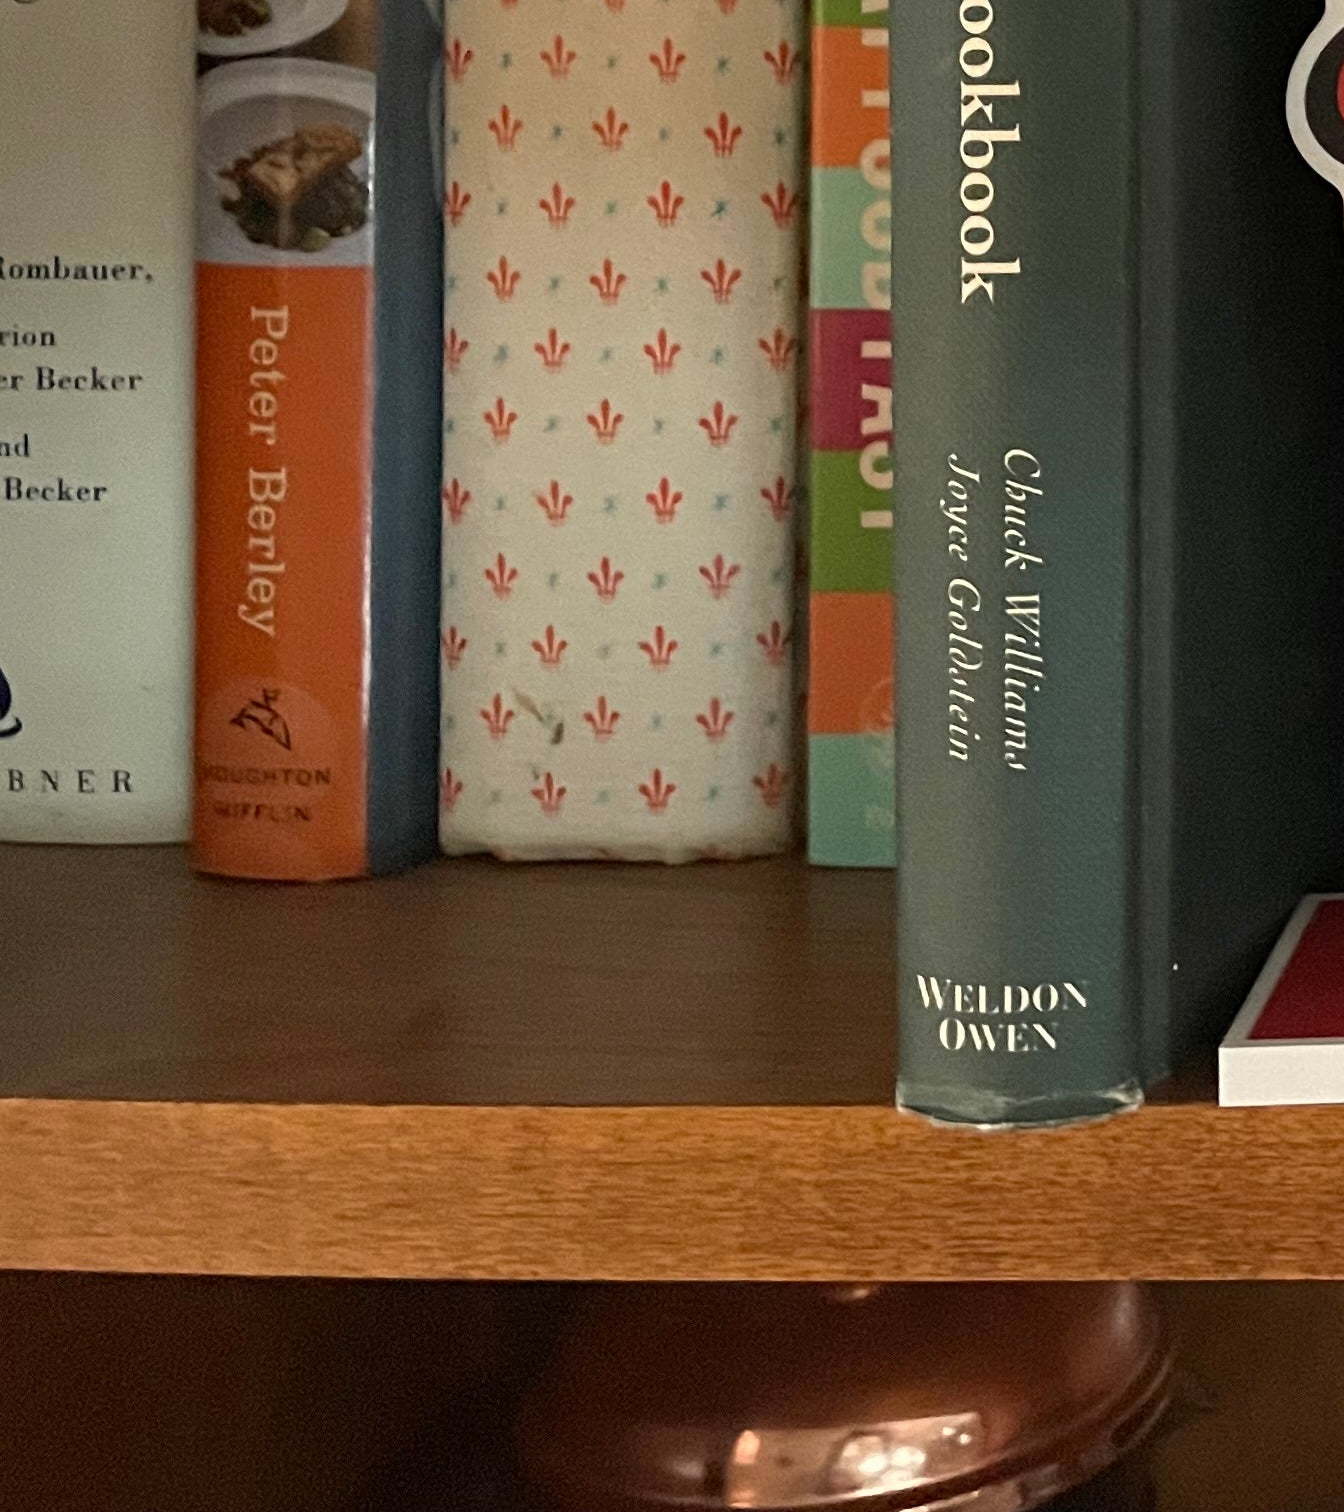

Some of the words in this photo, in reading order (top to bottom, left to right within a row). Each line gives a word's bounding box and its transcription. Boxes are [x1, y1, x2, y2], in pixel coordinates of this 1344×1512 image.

[0, 255, 154, 284] ombauer,
[35, 365, 144, 391] Becker
[248, 305, 289, 446] Peter
[3, 476, 108, 503] Becker
[938, 453, 981, 563] Joyce
[1003, 448, 1047, 571] Chuck
[238, 467, 288, 637] Berley
[947, 577, 984, 763] Goldstein
[1003, 592, 1047, 771] Williams
[916, 974, 1089, 1014] WELDON
[938, 1017, 1060, 1053] OWEN
